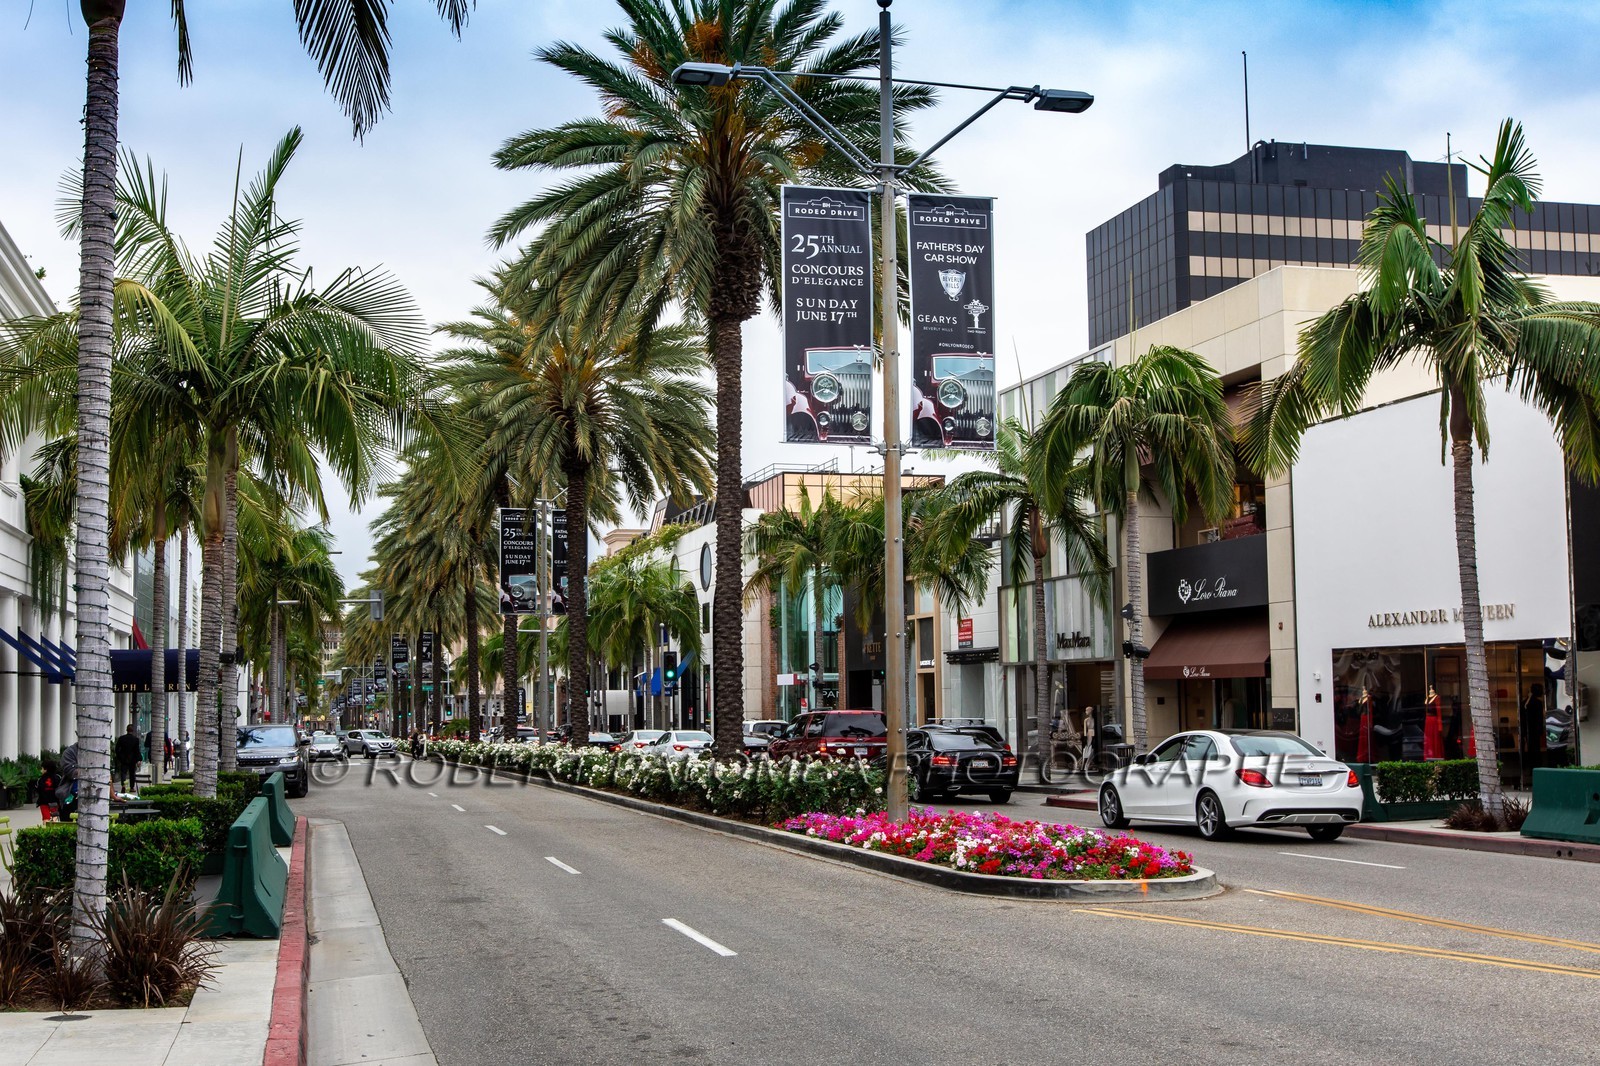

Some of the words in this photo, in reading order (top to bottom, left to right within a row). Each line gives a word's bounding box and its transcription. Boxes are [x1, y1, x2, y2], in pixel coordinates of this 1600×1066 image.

[819, 244, 863, 254] ANNUAL
[916, 242, 962, 253] FATHER'S
[964, 244, 985, 254] DAY
[924, 253, 944, 263] CAR
[946, 255, 977, 265] SHOW
[791, 264, 864, 276] CONCOURS
[791, 276, 864, 286] D'ELEGANCE
[796, 298, 859, 309] SUNDAY
[796, 311, 828, 322] JUNE
[917, 314, 958, 325] GEARYS
[1191, 579, 1212, 601] Loro
[1212, 575, 1237, 598] Piana
[1367, 608, 1448, 627] ALEXANDER
